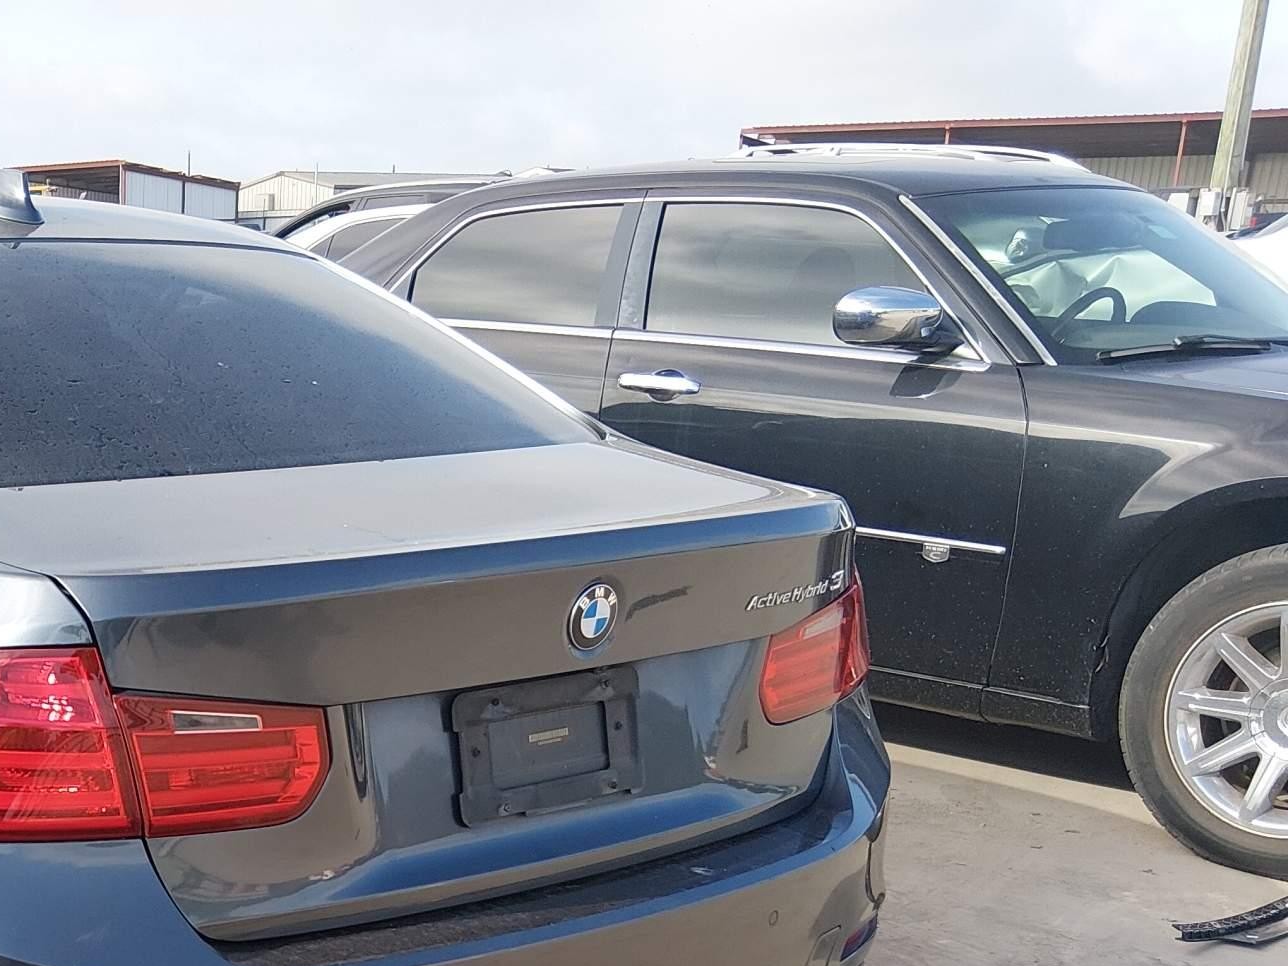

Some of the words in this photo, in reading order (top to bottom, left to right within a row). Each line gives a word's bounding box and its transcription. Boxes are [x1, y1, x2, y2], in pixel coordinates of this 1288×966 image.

[579, 586, 617, 610] BMW
[745, 580, 829, 611] ActiveHybrid
[829, 569, 845, 592] 3
